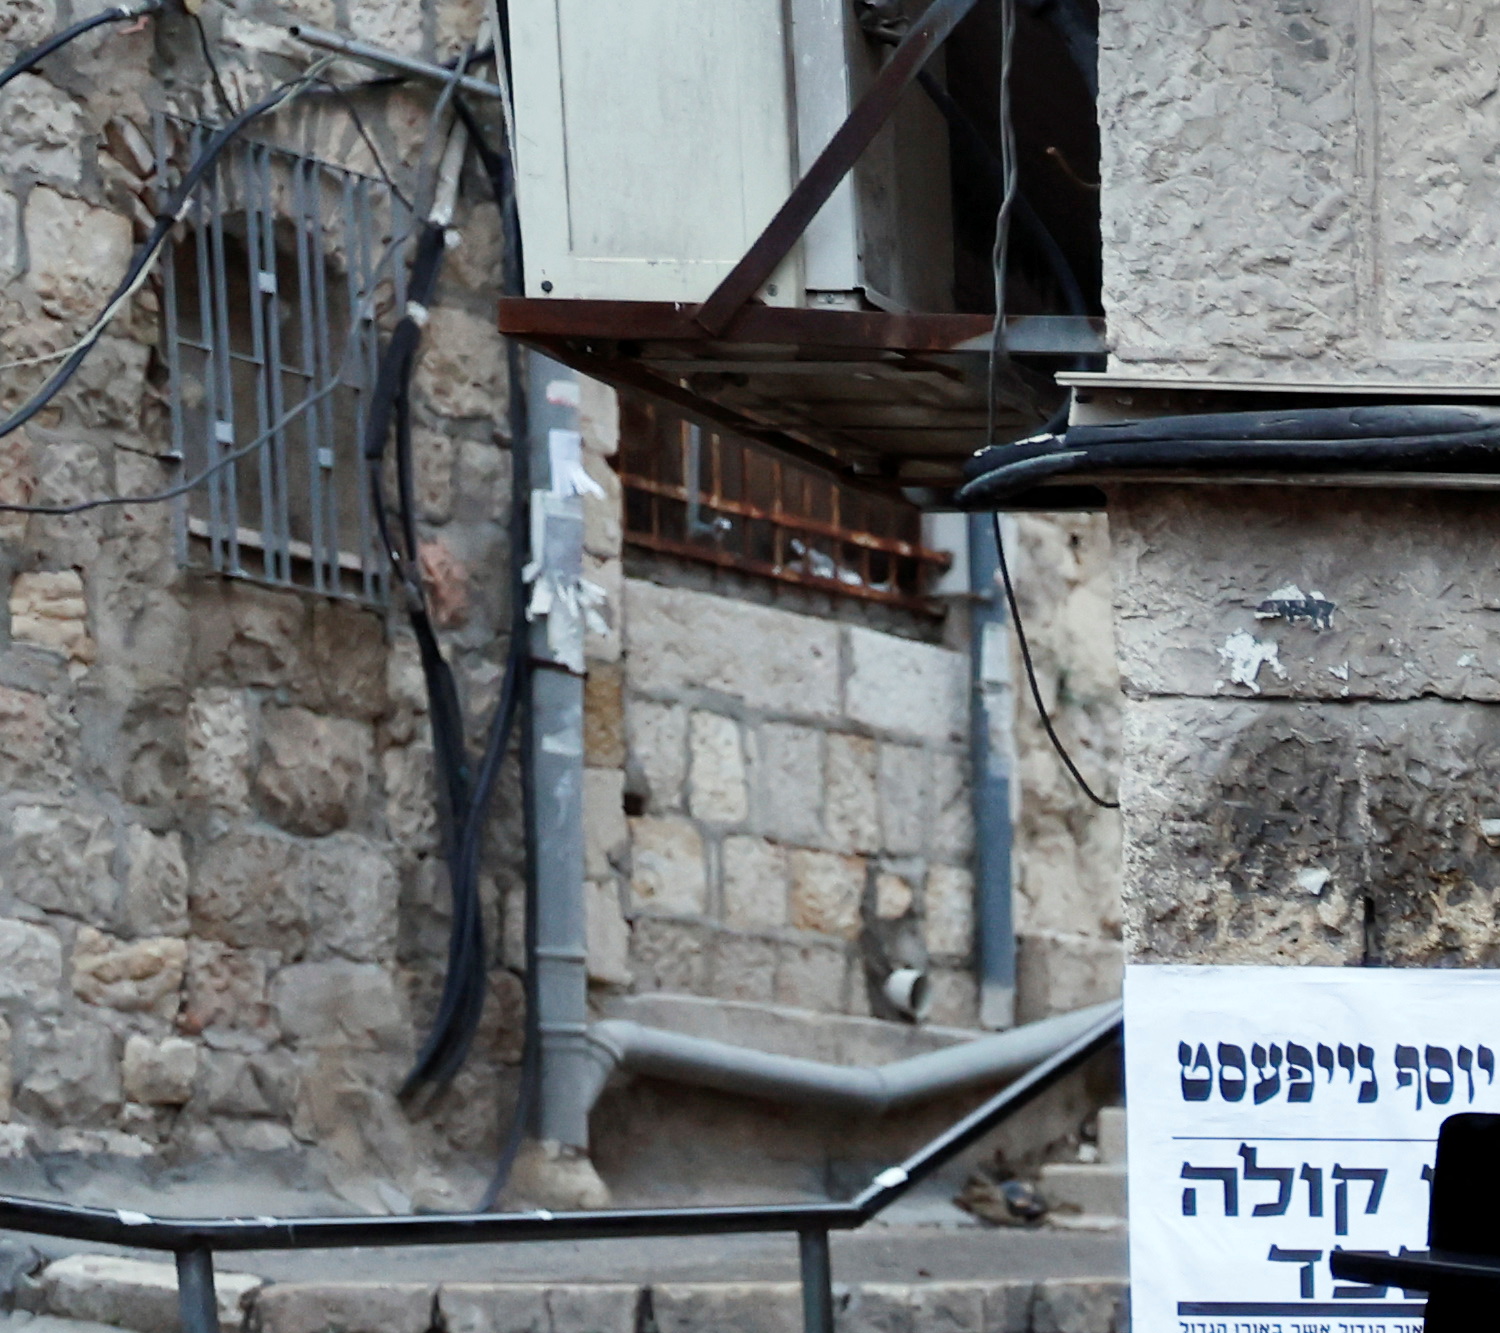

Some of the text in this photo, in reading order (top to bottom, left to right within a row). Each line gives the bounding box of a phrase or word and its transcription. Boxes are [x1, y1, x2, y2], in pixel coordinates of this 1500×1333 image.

[1177, 1040, 1379, 1106] נייפעסט
[1394, 1043, 1495, 1111] יוסף
[1179, 1142, 1389, 1236] קולה
